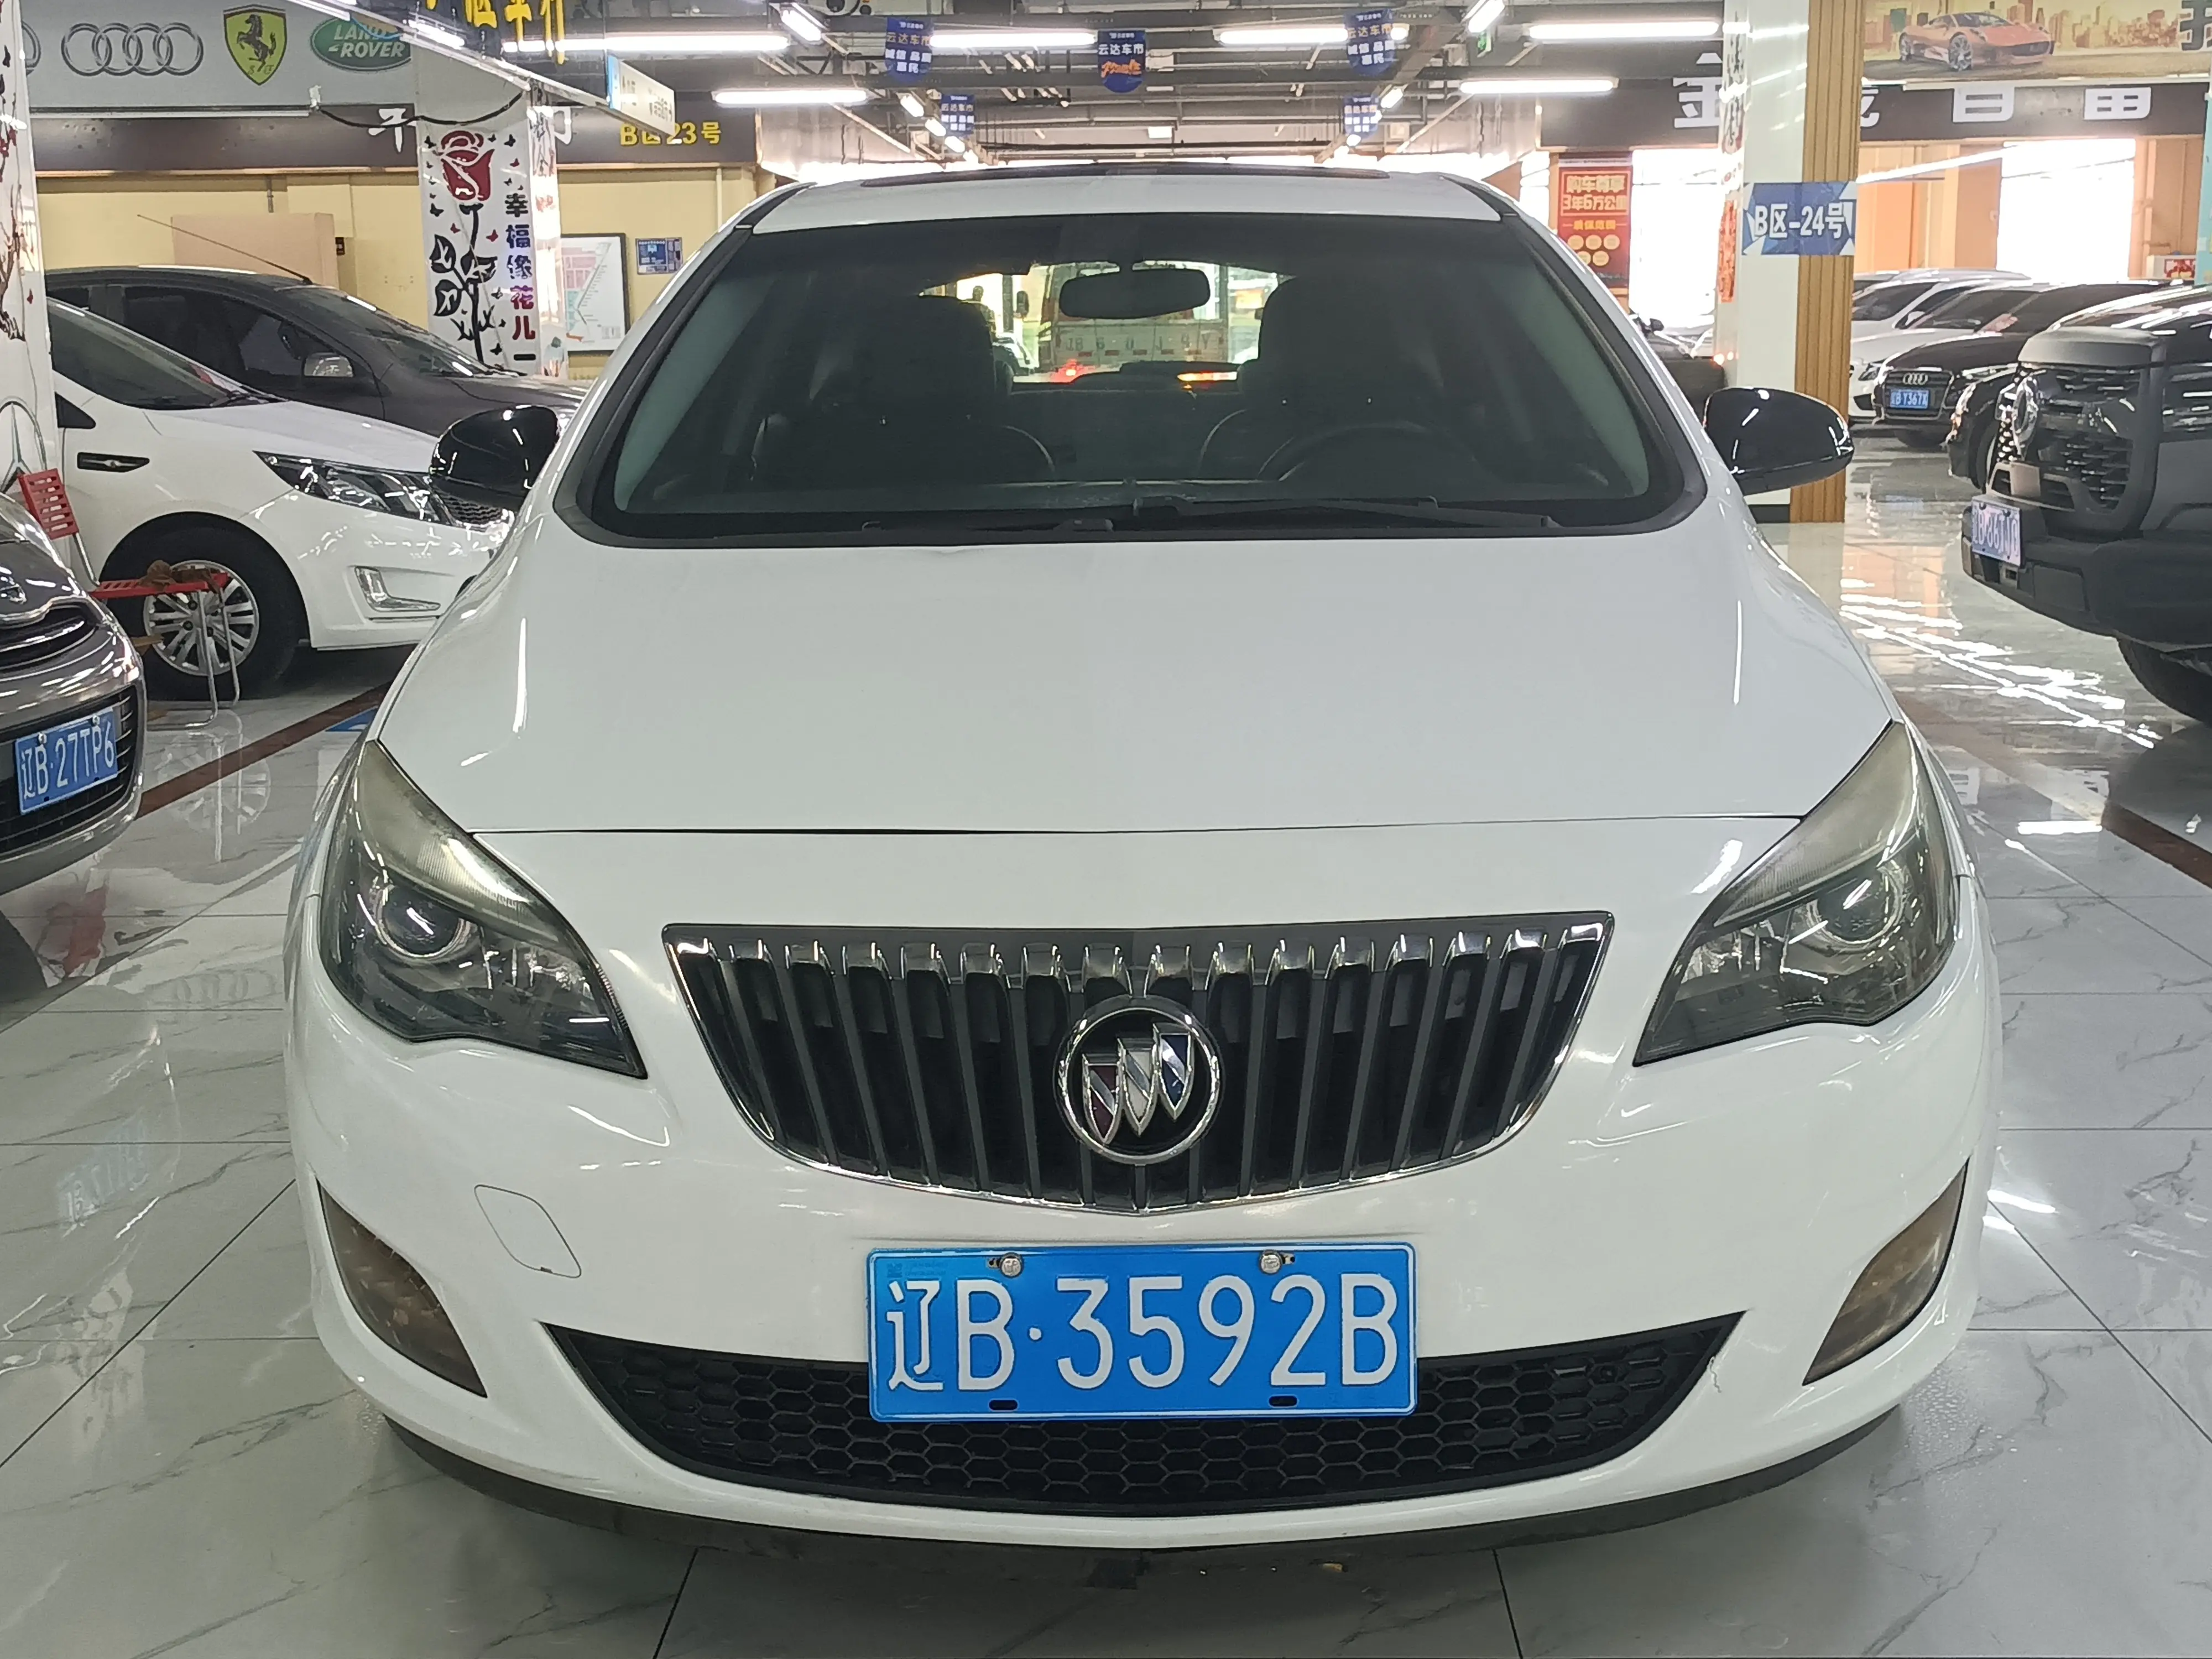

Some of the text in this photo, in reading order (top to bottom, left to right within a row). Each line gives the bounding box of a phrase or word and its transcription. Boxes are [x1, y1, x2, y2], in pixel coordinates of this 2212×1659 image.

[340, 42, 405, 58] ROVER
[1098, 43, 1144, 55] 云达车市
[1754, 202, 1845, 239] B区-24号
[22, 721, 114, 800] 辽B·27TP6
[886, 1273, 1399, 1391] 辽B·3592B
